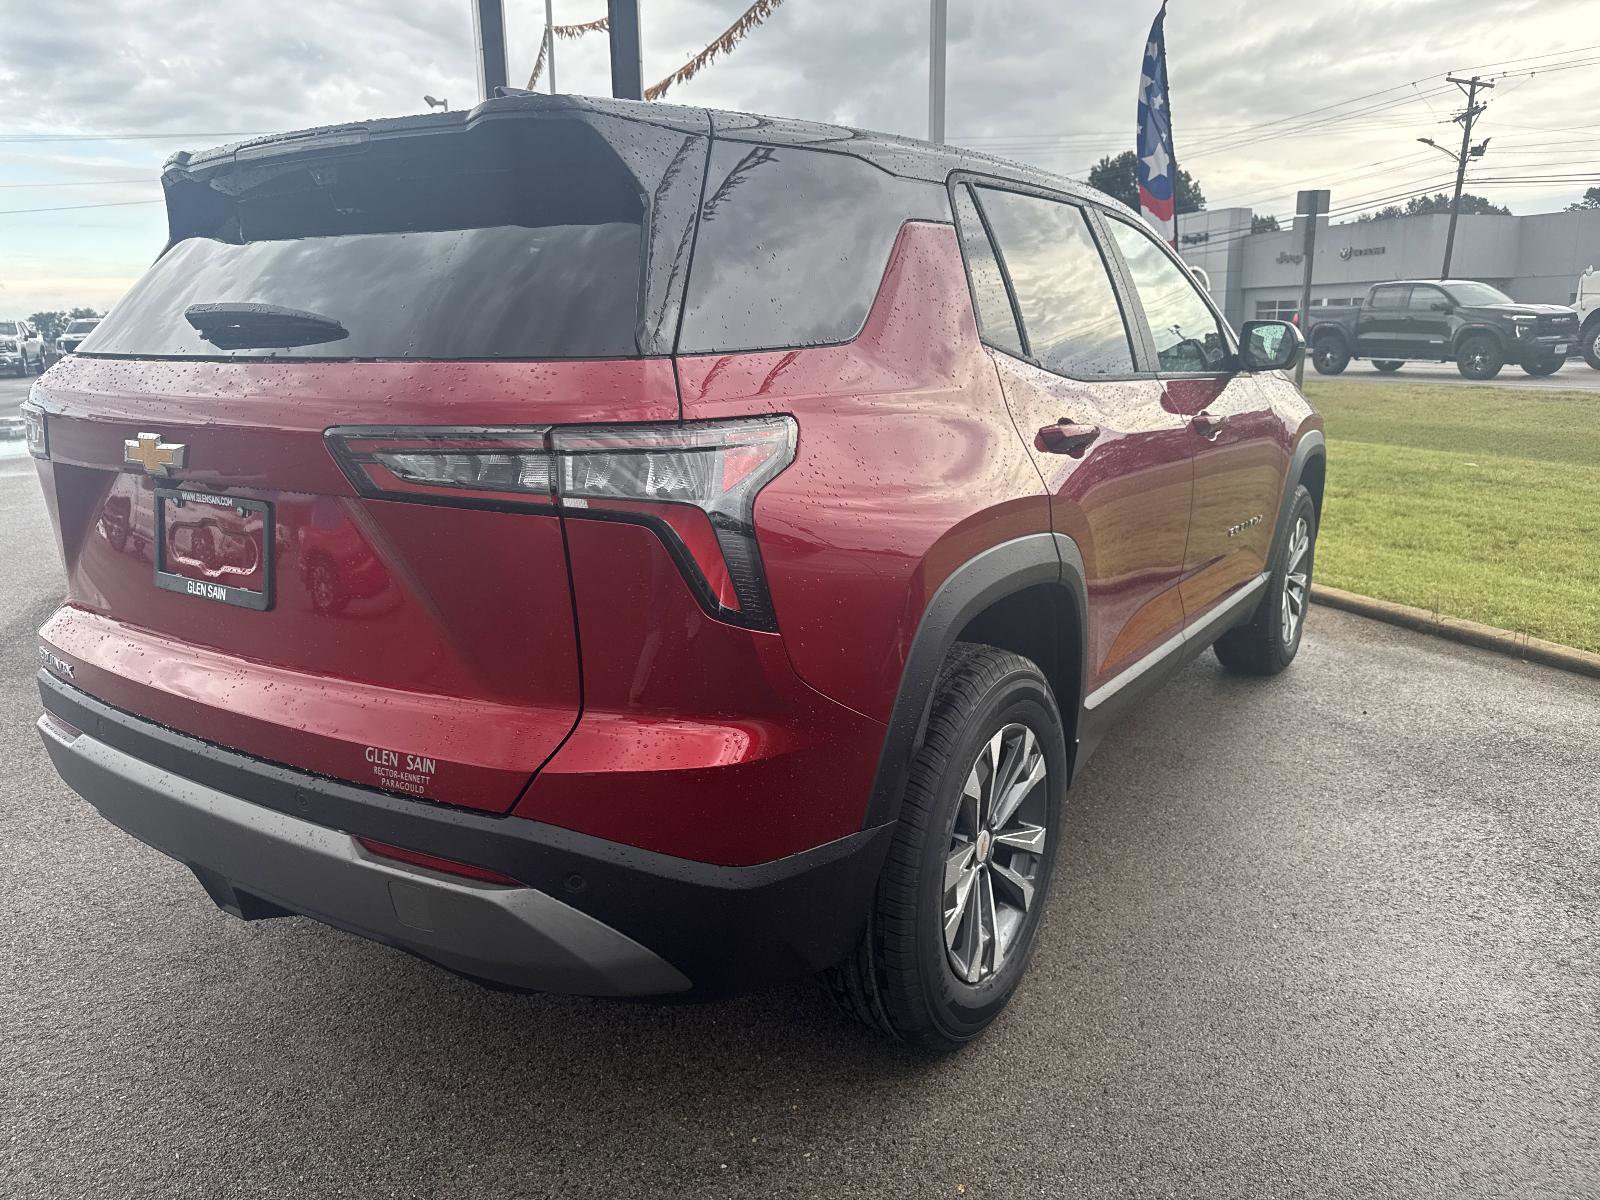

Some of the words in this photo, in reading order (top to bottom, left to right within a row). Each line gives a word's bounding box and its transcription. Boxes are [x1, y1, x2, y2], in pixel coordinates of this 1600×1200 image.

[181, 490, 233, 507] WWW.GLENSAIN.COM
[187, 580, 207, 597] GLEN
[207, 584, 227, 601] SAIN
[365, 746, 398, 768] GLEN
[406, 754, 436, 775] SAIN
[373, 765, 431, 785] RECTOR-KENNETT
[381, 777, 425, 794] PARAGOULD
